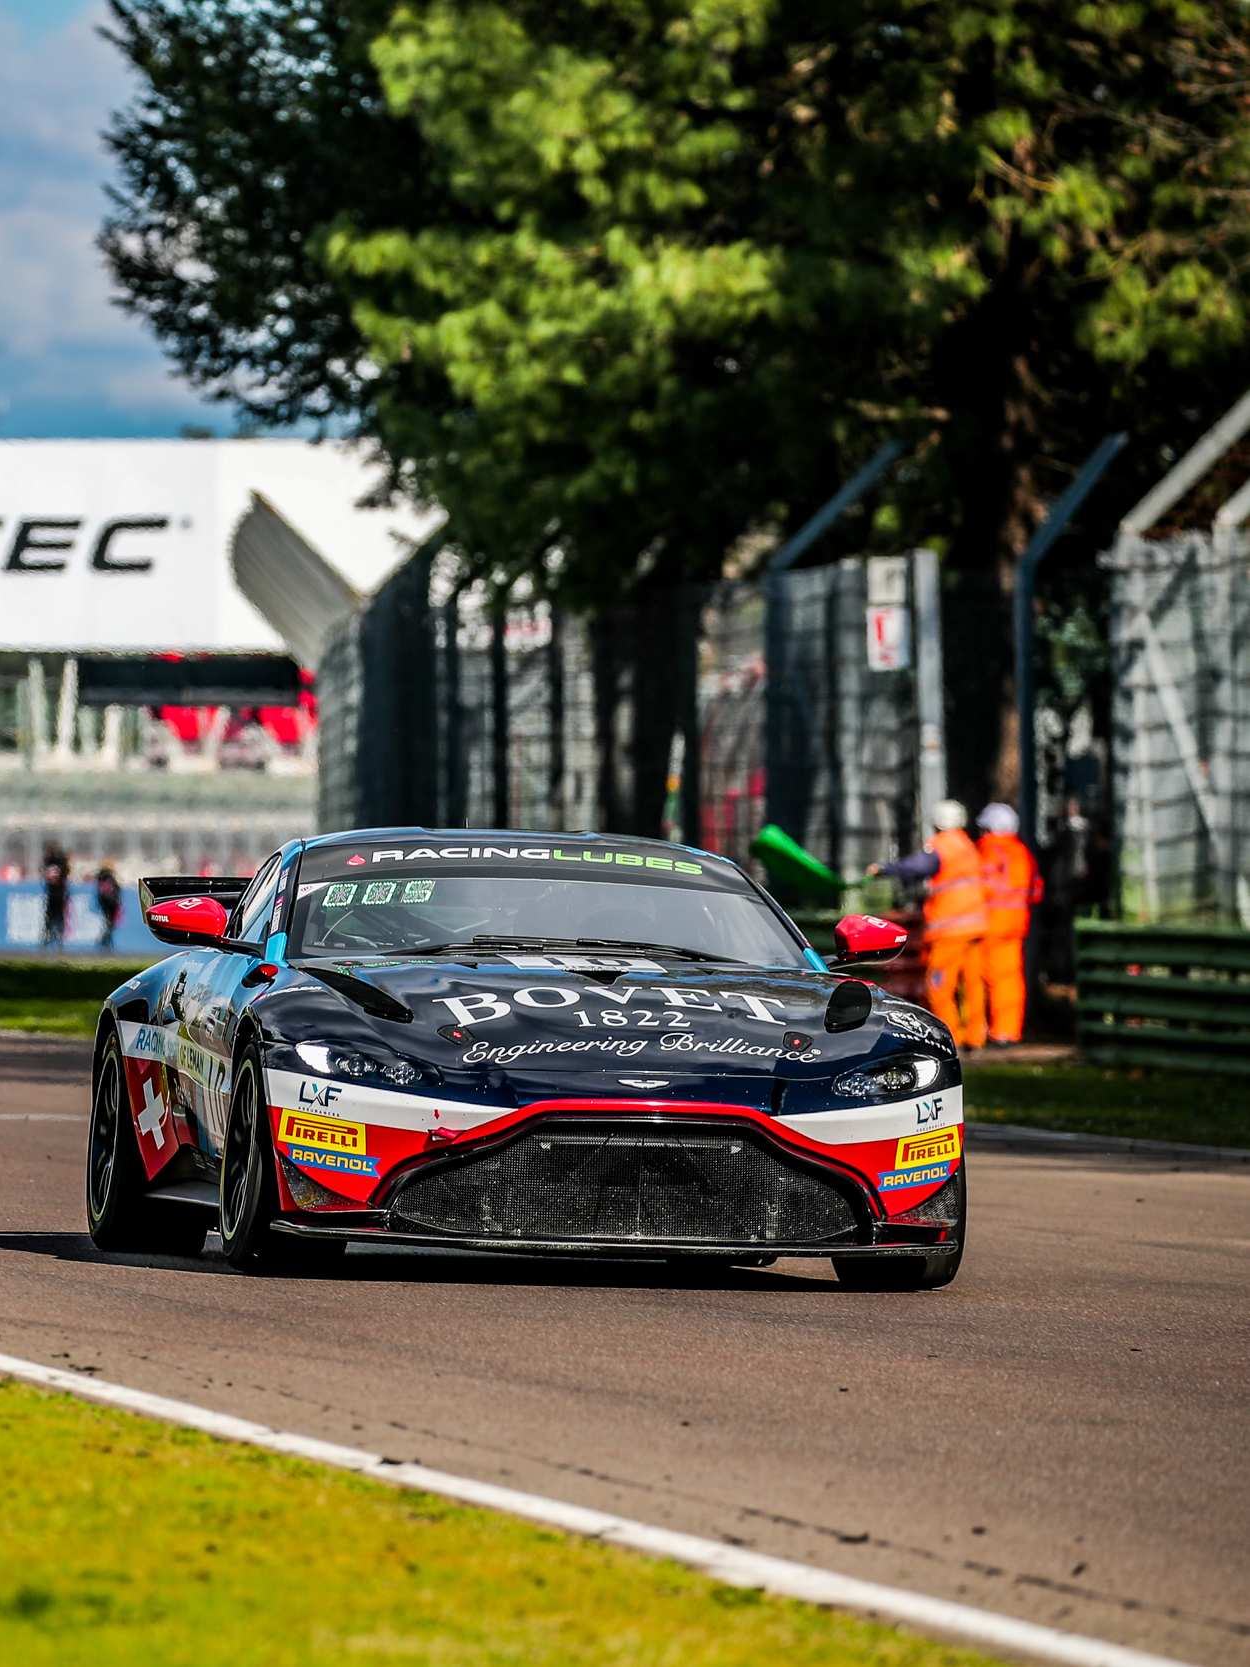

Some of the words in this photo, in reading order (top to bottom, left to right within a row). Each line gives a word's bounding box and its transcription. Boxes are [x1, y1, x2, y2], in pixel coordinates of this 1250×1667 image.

[371, 846, 703, 876] RACINGLUBES
[432, 985, 787, 1028] BOVET
[573, 1009, 693, 1028] 1822
[462, 1035, 649, 1065] Engineering
[298, 1106, 340, 1118] ASSURANCES
[285, 1115, 359, 1148] PIRELLI
[291, 1148, 373, 1172] RAVENOL
[901, 1132, 955, 1163] PIRELLI
[882, 1166, 947, 1187] RAVENOL
